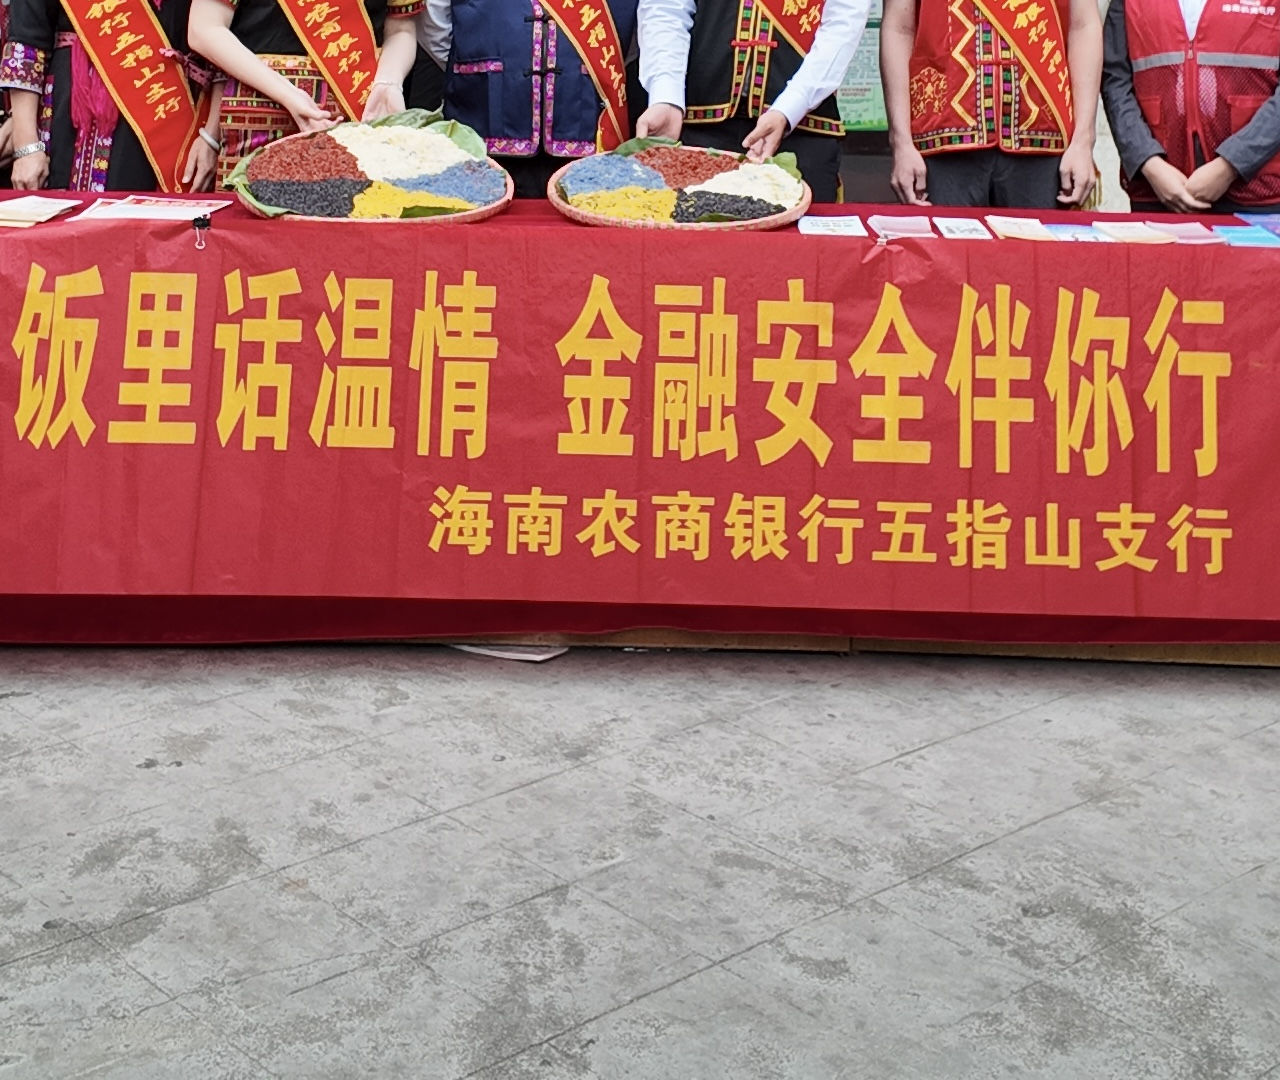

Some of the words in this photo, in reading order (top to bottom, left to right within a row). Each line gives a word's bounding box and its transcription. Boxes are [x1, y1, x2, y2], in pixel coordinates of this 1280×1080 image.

[554, 271, 1233, 478] 金融安全伴你行
[428, 484, 1234, 576] 海南农商银行五指山支行
